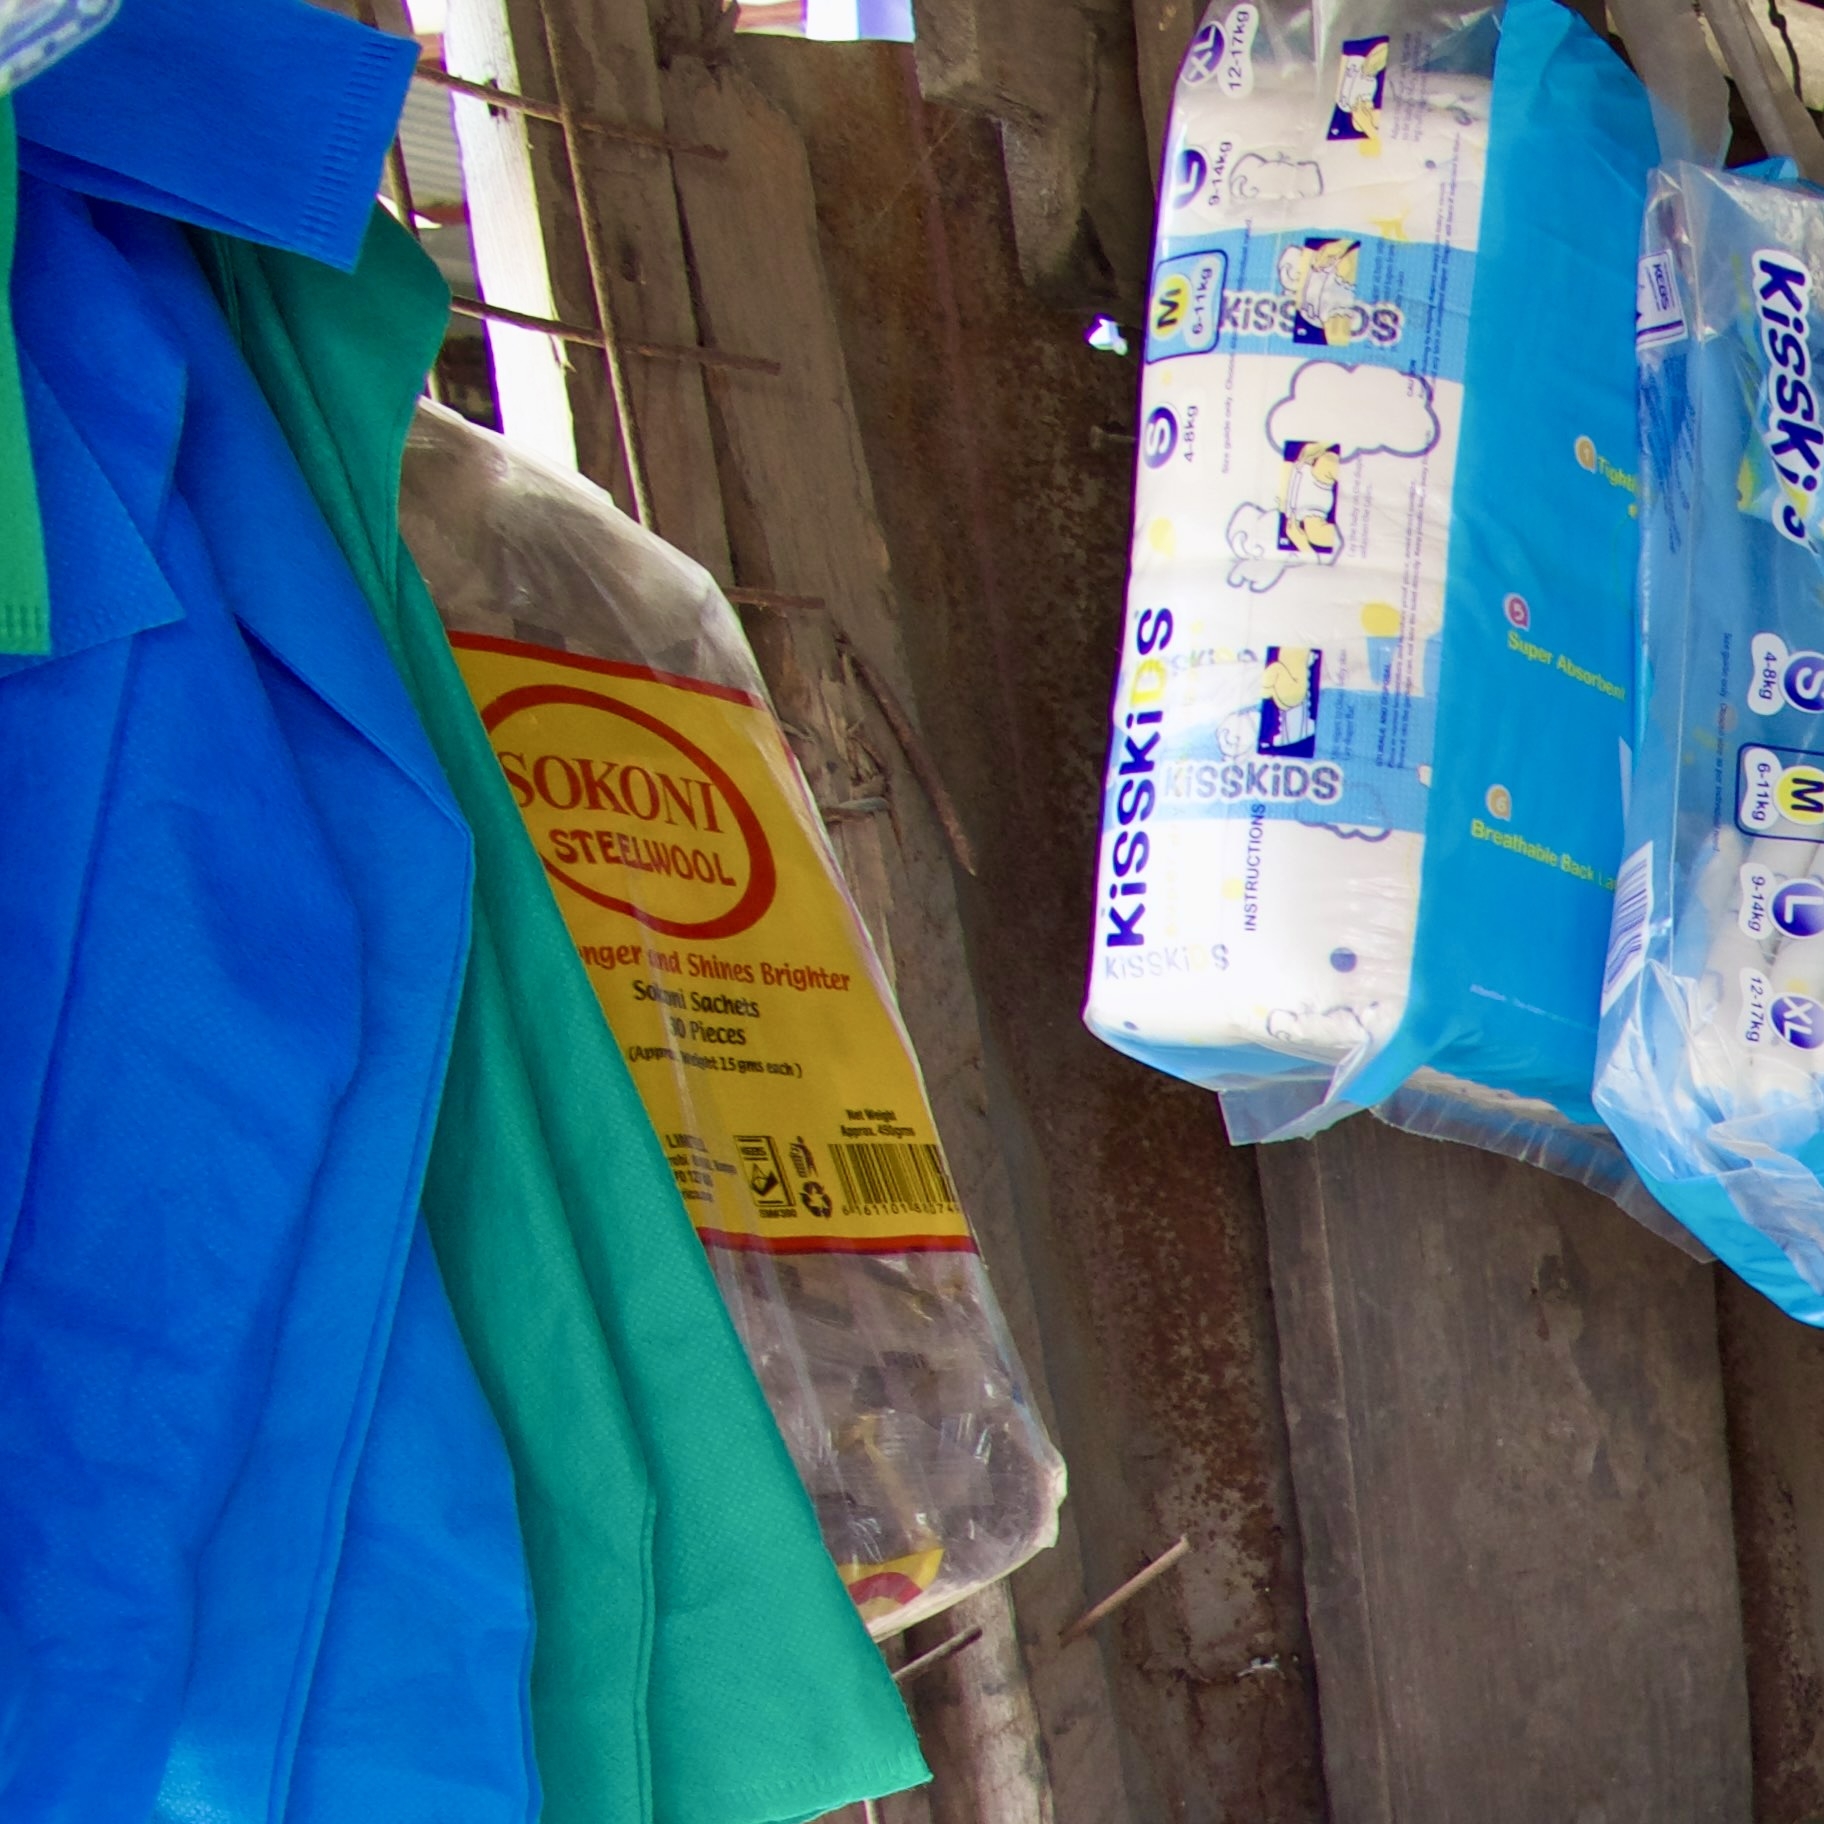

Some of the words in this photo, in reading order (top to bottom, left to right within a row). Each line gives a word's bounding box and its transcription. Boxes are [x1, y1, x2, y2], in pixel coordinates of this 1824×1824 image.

[1228, 10, 1252, 91] 12-17kg
[1208, 140, 1234, 207] 9-14kg
[1155, 288, 1183, 328] M
[1191, 266, 1214, 336] 6-11kg
[1146, 417, 1173, 456] S
[1182, 404, 1199, 463] 4-8kg
[1507, 630, 1554, 666] Super
[1556, 647, 1627, 702] Absorbent
[1758, 650, 1778, 702] 4-8kg
[499, 749, 726, 835] SOKONI
[1751, 761, 1772, 822] 6-11kg
[547, 828, 738, 888] STEELWOOL
[1243, 802, 1267, 932] INSTRUCTIONS
[1470, 819, 1559, 868] Breathable
[1561, 852, 1596, 881] Back
[1747, 875, 1766, 932] 9-14kg
[1784, 895, 1824, 924] L
[687, 952, 755, 985] Shines
[759, 961, 851, 993] Brighter
[690, 990, 761, 1019] Sachets
[690, 1018, 748, 1046] Pieces
[1744, 976, 1763, 1043] 12-17kg
[1781, 996, 1815, 1044] XL
